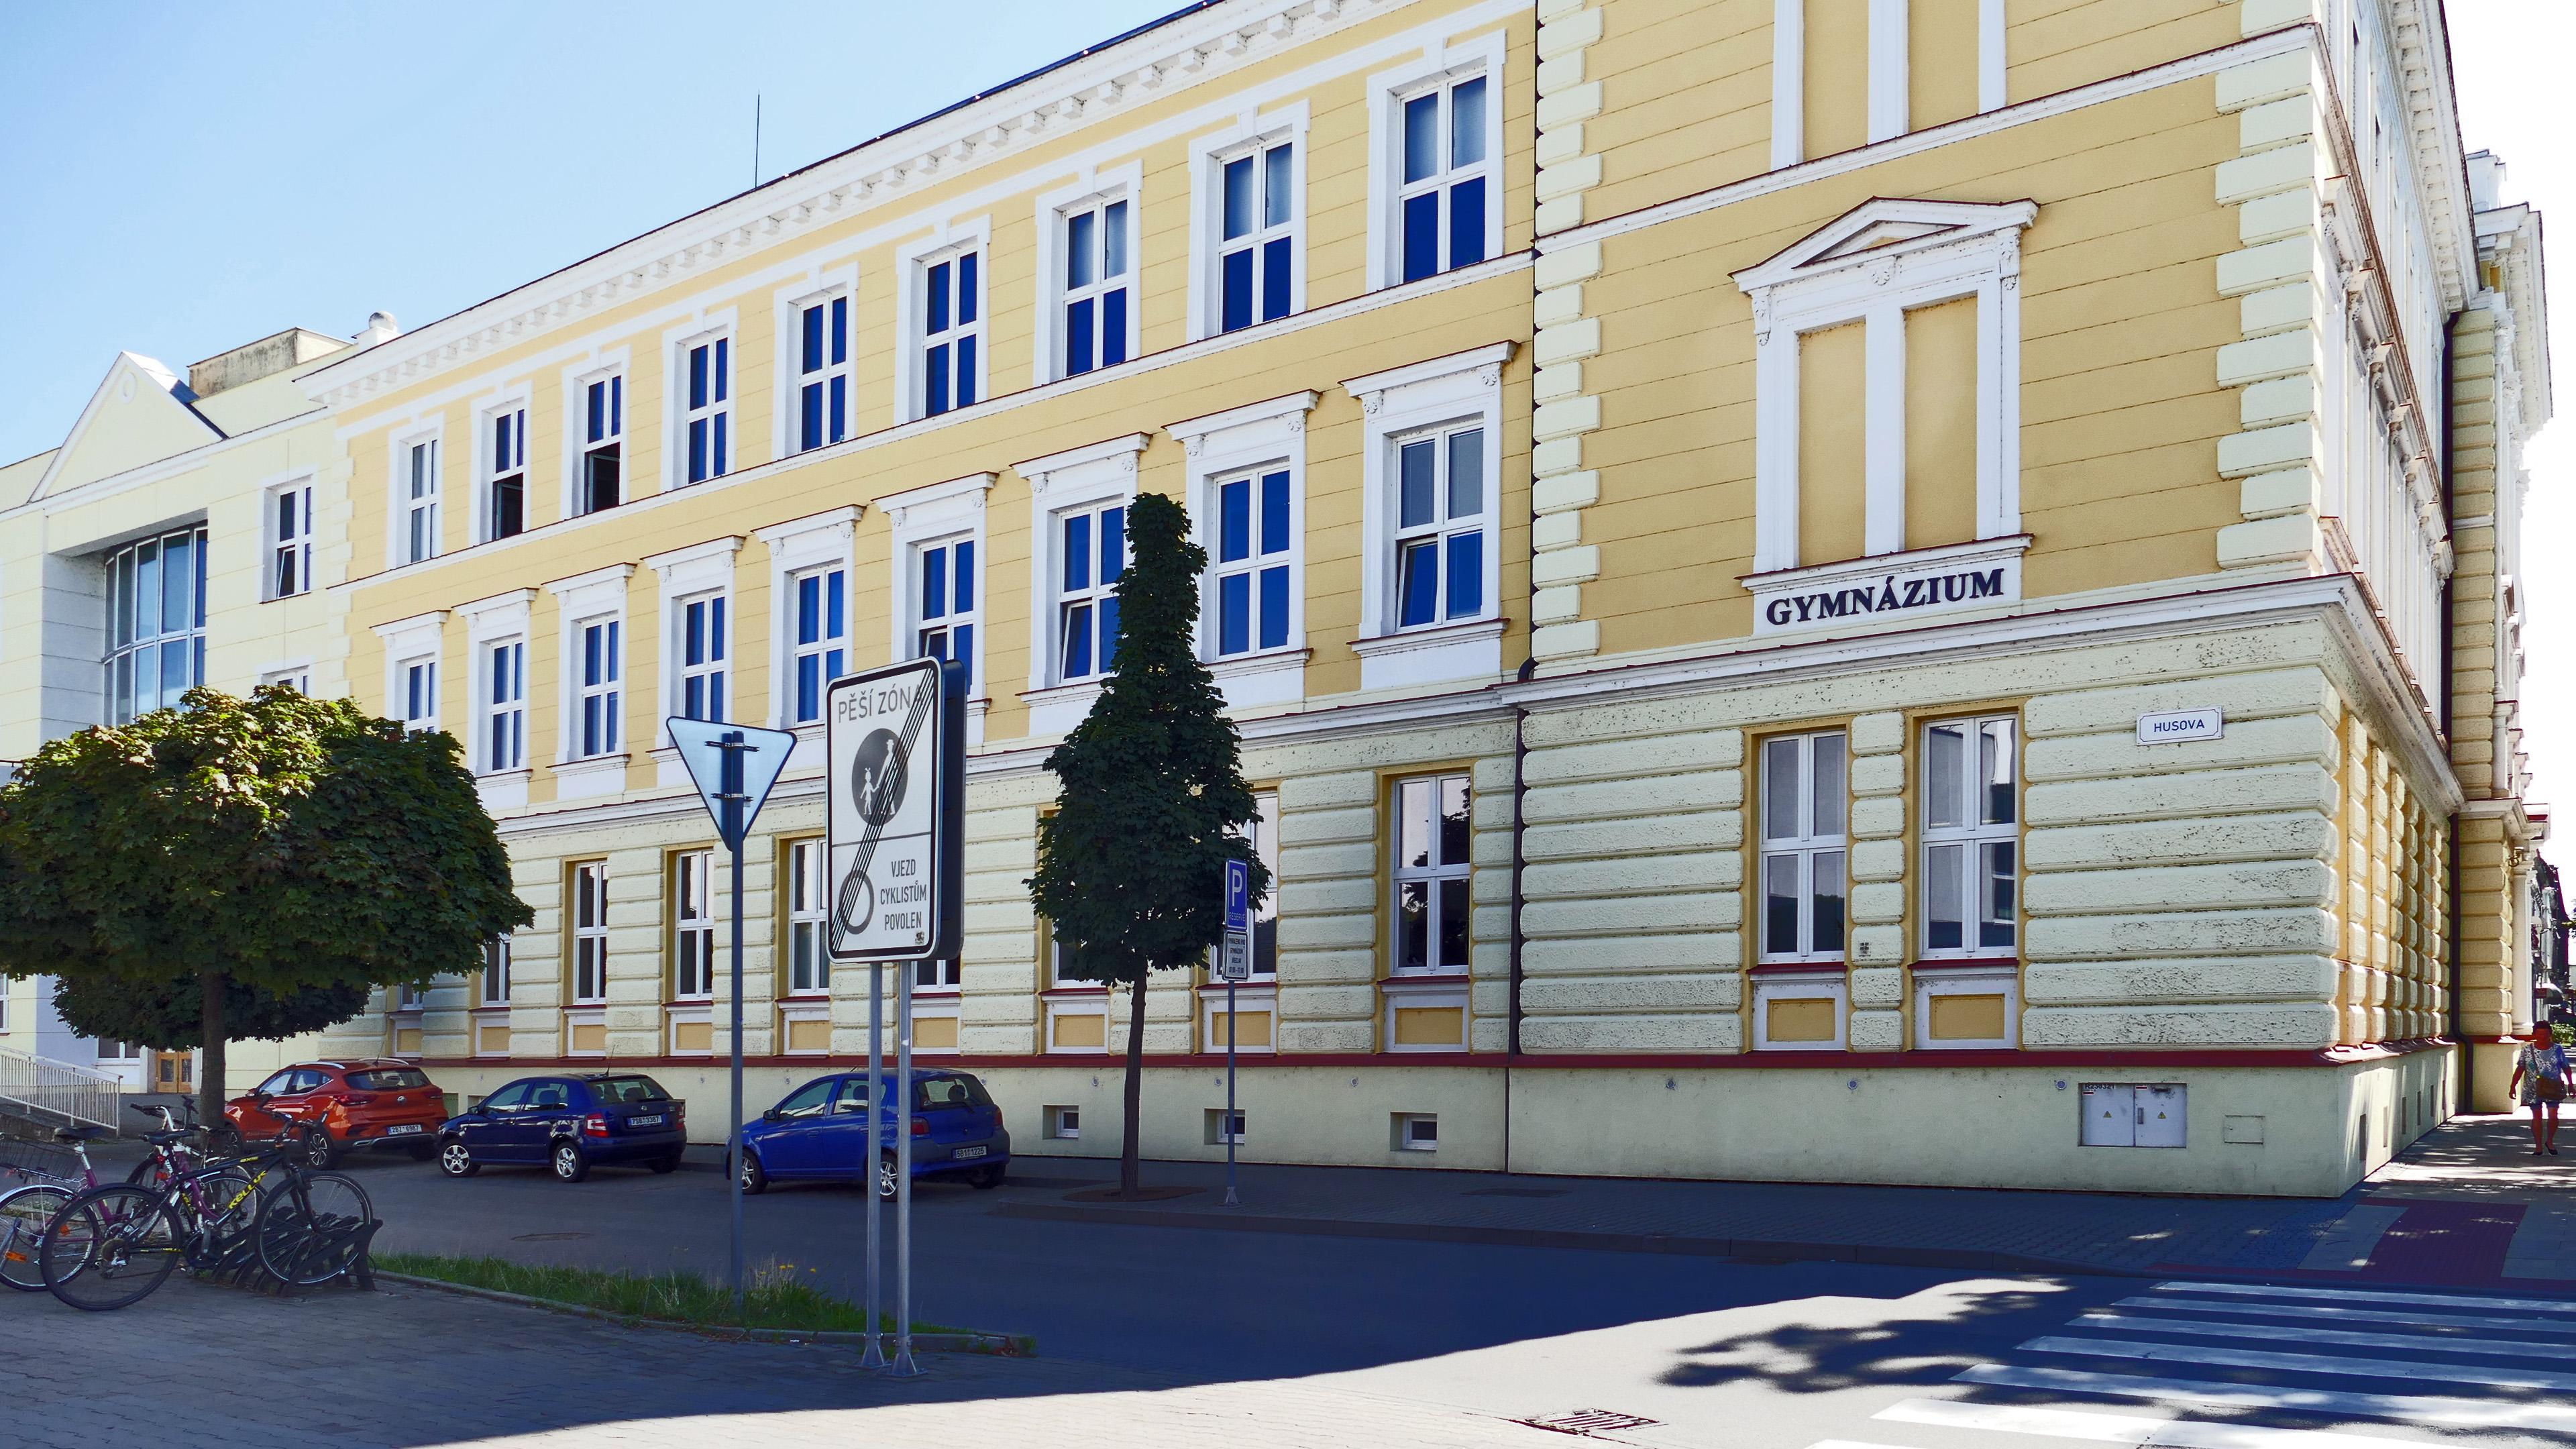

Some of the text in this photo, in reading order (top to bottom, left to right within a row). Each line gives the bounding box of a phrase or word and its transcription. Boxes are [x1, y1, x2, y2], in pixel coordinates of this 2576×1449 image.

[1766, 568, 2005, 626] GYMNÁZIUM
[838, 688, 874, 724] PĚŠÍ
[2153, 718, 2205, 733] HUSOVA
[891, 859, 916, 877] VJEZD
[880, 880, 927, 905] CYKLISTŮM
[1232, 869, 1242, 907] P
[885, 911, 922, 931] POVOLEN
